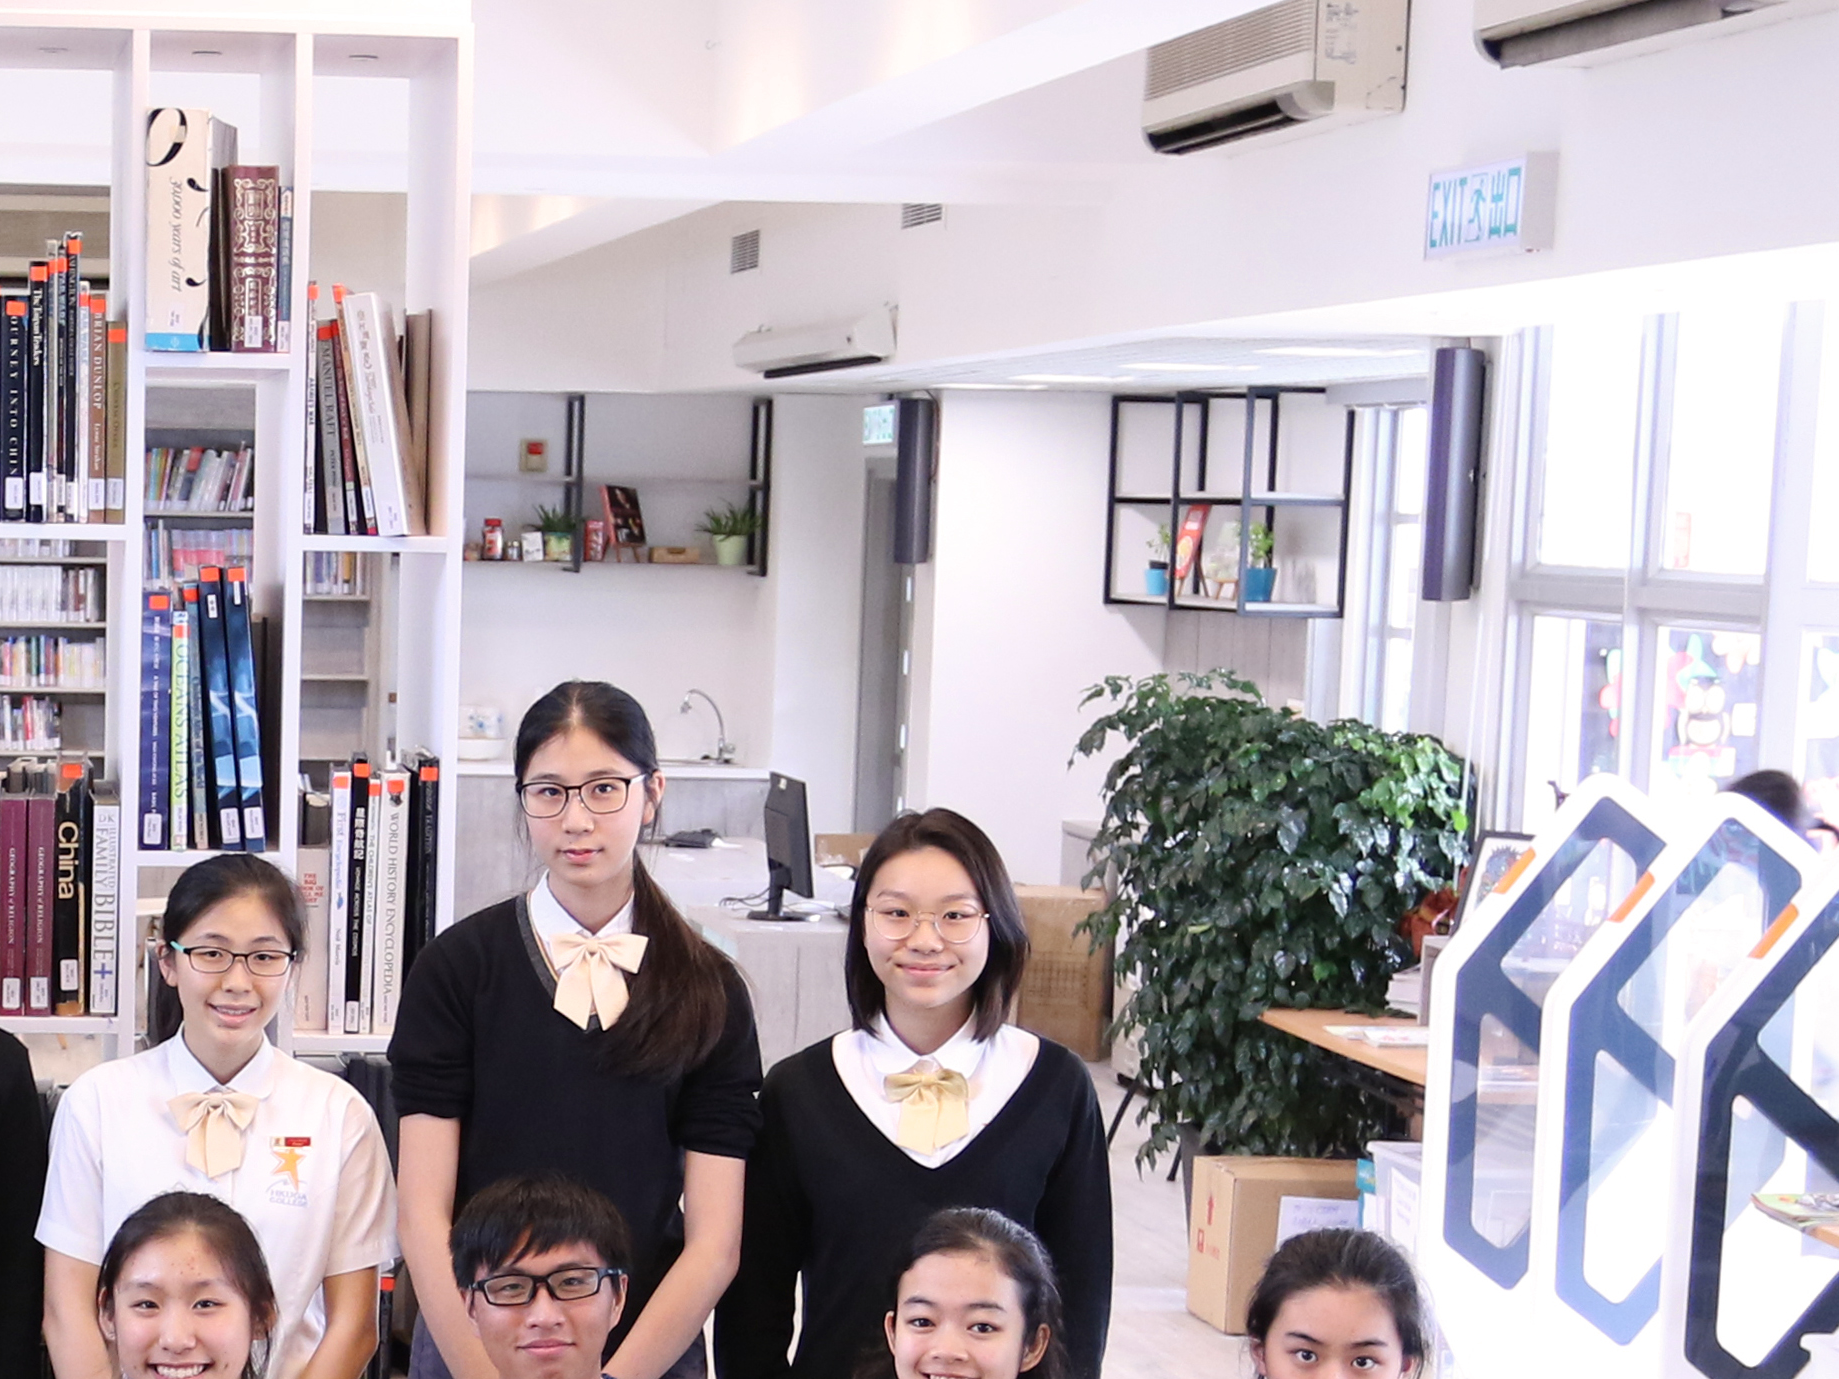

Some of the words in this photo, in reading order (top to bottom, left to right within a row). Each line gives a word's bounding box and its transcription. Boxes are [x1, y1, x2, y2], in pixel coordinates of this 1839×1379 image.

[167, 177, 183, 219] 30,000
[1430, 176, 1468, 249] EXIT
[1488, 166, 1522, 240] 出口
[169, 222, 184, 254] years
[68, 254, 76, 307] ASHINGTON
[169, 257, 185, 270] of
[171, 269, 185, 292] art
[34, 288, 43, 305] The
[32, 305, 43, 334] Taipan
[92, 312, 103, 352] BRIAN
[9, 315, 19, 380] OURNEY
[34, 333, 43, 366] Traders
[92, 356, 103, 410] DUNLOP
[320, 341, 335, 402] EMANUEL
[9, 389, 19, 428] INTO
[324, 403, 336, 438] RAFT
[9, 436, 19, 476] CHIN
[174, 643, 189, 728] OCEANS
[173, 735, 188, 799] ATLAS
[336, 811, 347, 838] First
[388, 812, 401, 854] WORLD
[7, 847, 16, 898] GEOGRAPHY
[36, 846, 45, 897] GEOGRAPHY
[57, 820, 79, 900] China
[95, 827, 108, 888] FAMILY
[107, 827, 117, 888] ILLUSTRATED
[366, 849, 375, 890] CHILDREN'S
[365, 891, 374, 913] ATLAS
[386, 857, 398, 907] HISTORY
[7, 904, 16, 945] RELIGION
[36, 904, 45, 944] RELIGION
[92, 892, 116, 961] BIBLE
[351, 931, 359, 957] COSMOS
[352, 918, 360, 930] THE
[382, 908, 397, 995] ENCYCLOPEDIA
